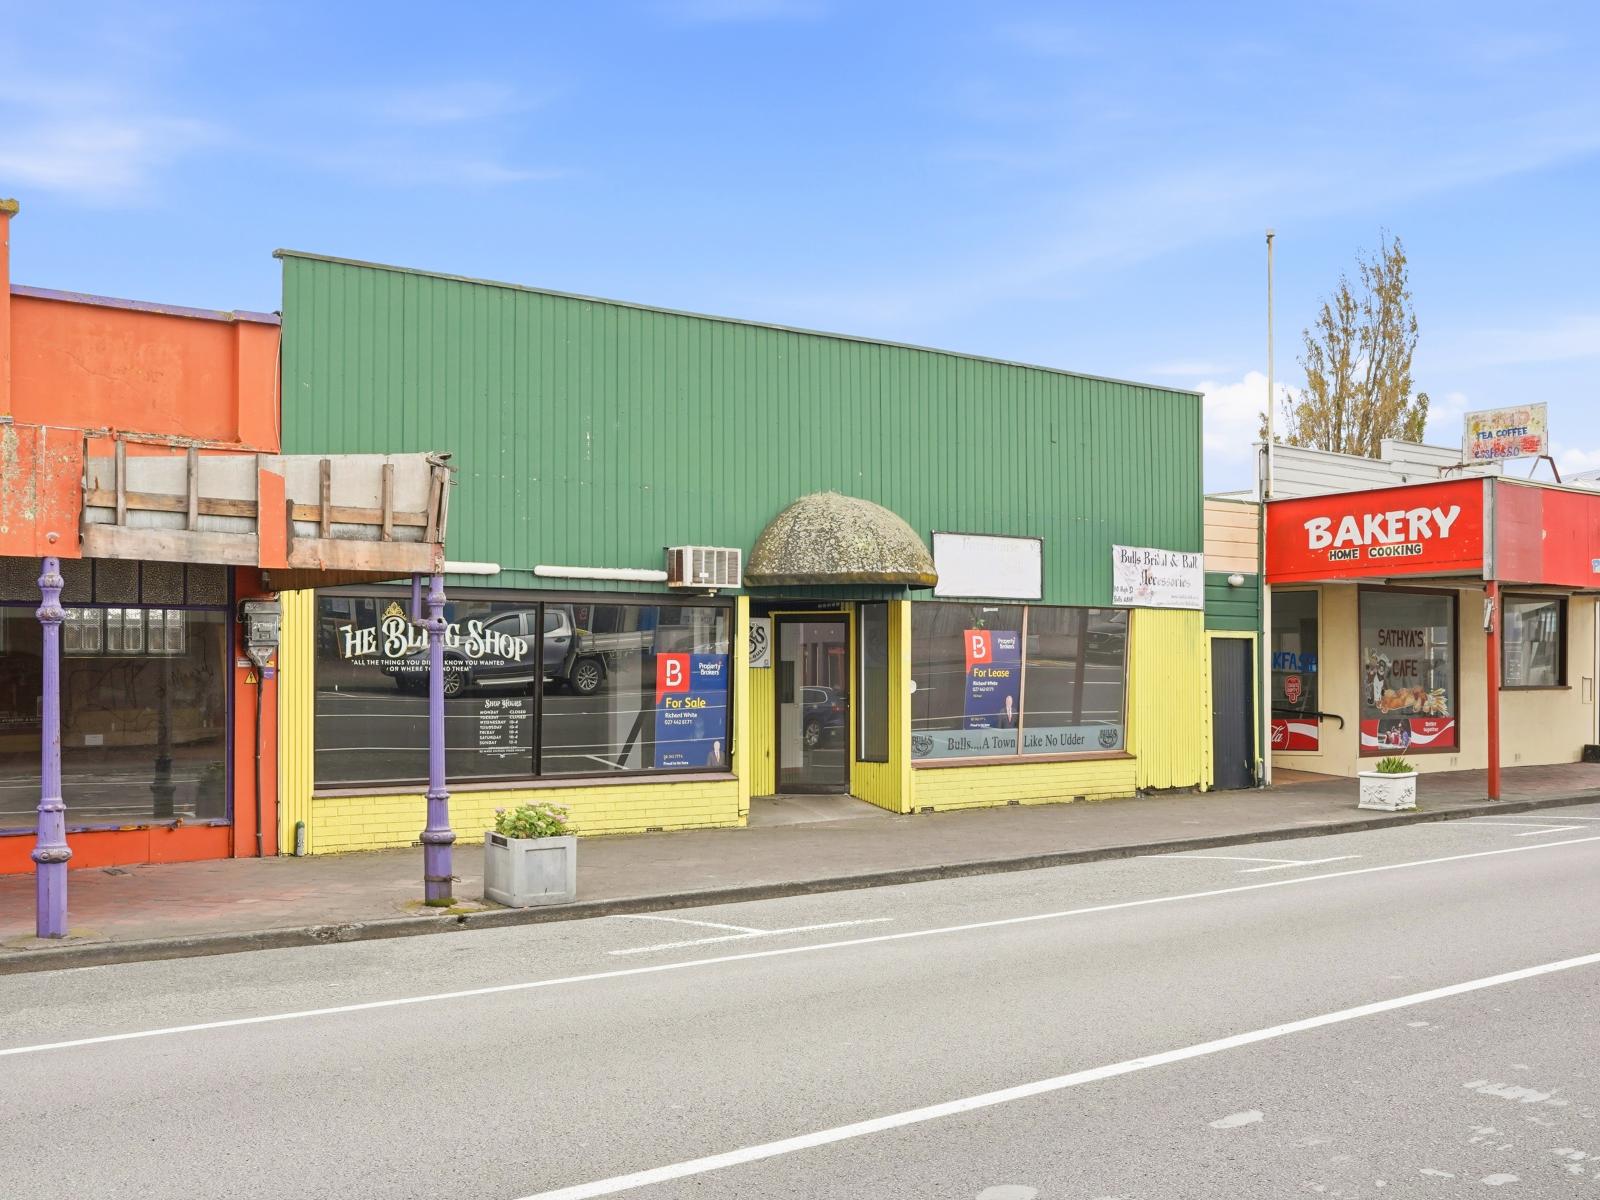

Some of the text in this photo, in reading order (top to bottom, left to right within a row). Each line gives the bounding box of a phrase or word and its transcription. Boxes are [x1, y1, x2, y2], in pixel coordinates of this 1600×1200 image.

[1476, 427, 1528, 441] TEA COFFEE
[1304, 505, 1461, 549] BAKERY
[1120, 549, 1141, 564] Bulls
[1329, 544, 1422, 560] HOME COOKING
[382, 616, 460, 658] BLIG
[465, 619, 528, 662] SHOP
[972, 635, 986, 659] B
[1378, 630, 1424, 648] SATHYA'S
[666, 659, 682, 687] B
[699, 662, 721, 671] Property
[973, 667, 1010, 678] For Lease
[1392, 660, 1418, 677] CAFE
[484, 699, 522, 708] SHOP HOURS
[665, 697, 706, 708] For Sale
[992, 736, 1016, 749] Town
[1024, 734, 1043, 748] Like
[1045, 733, 1058, 747] No
[1060, 732, 1085, 746] Udder
